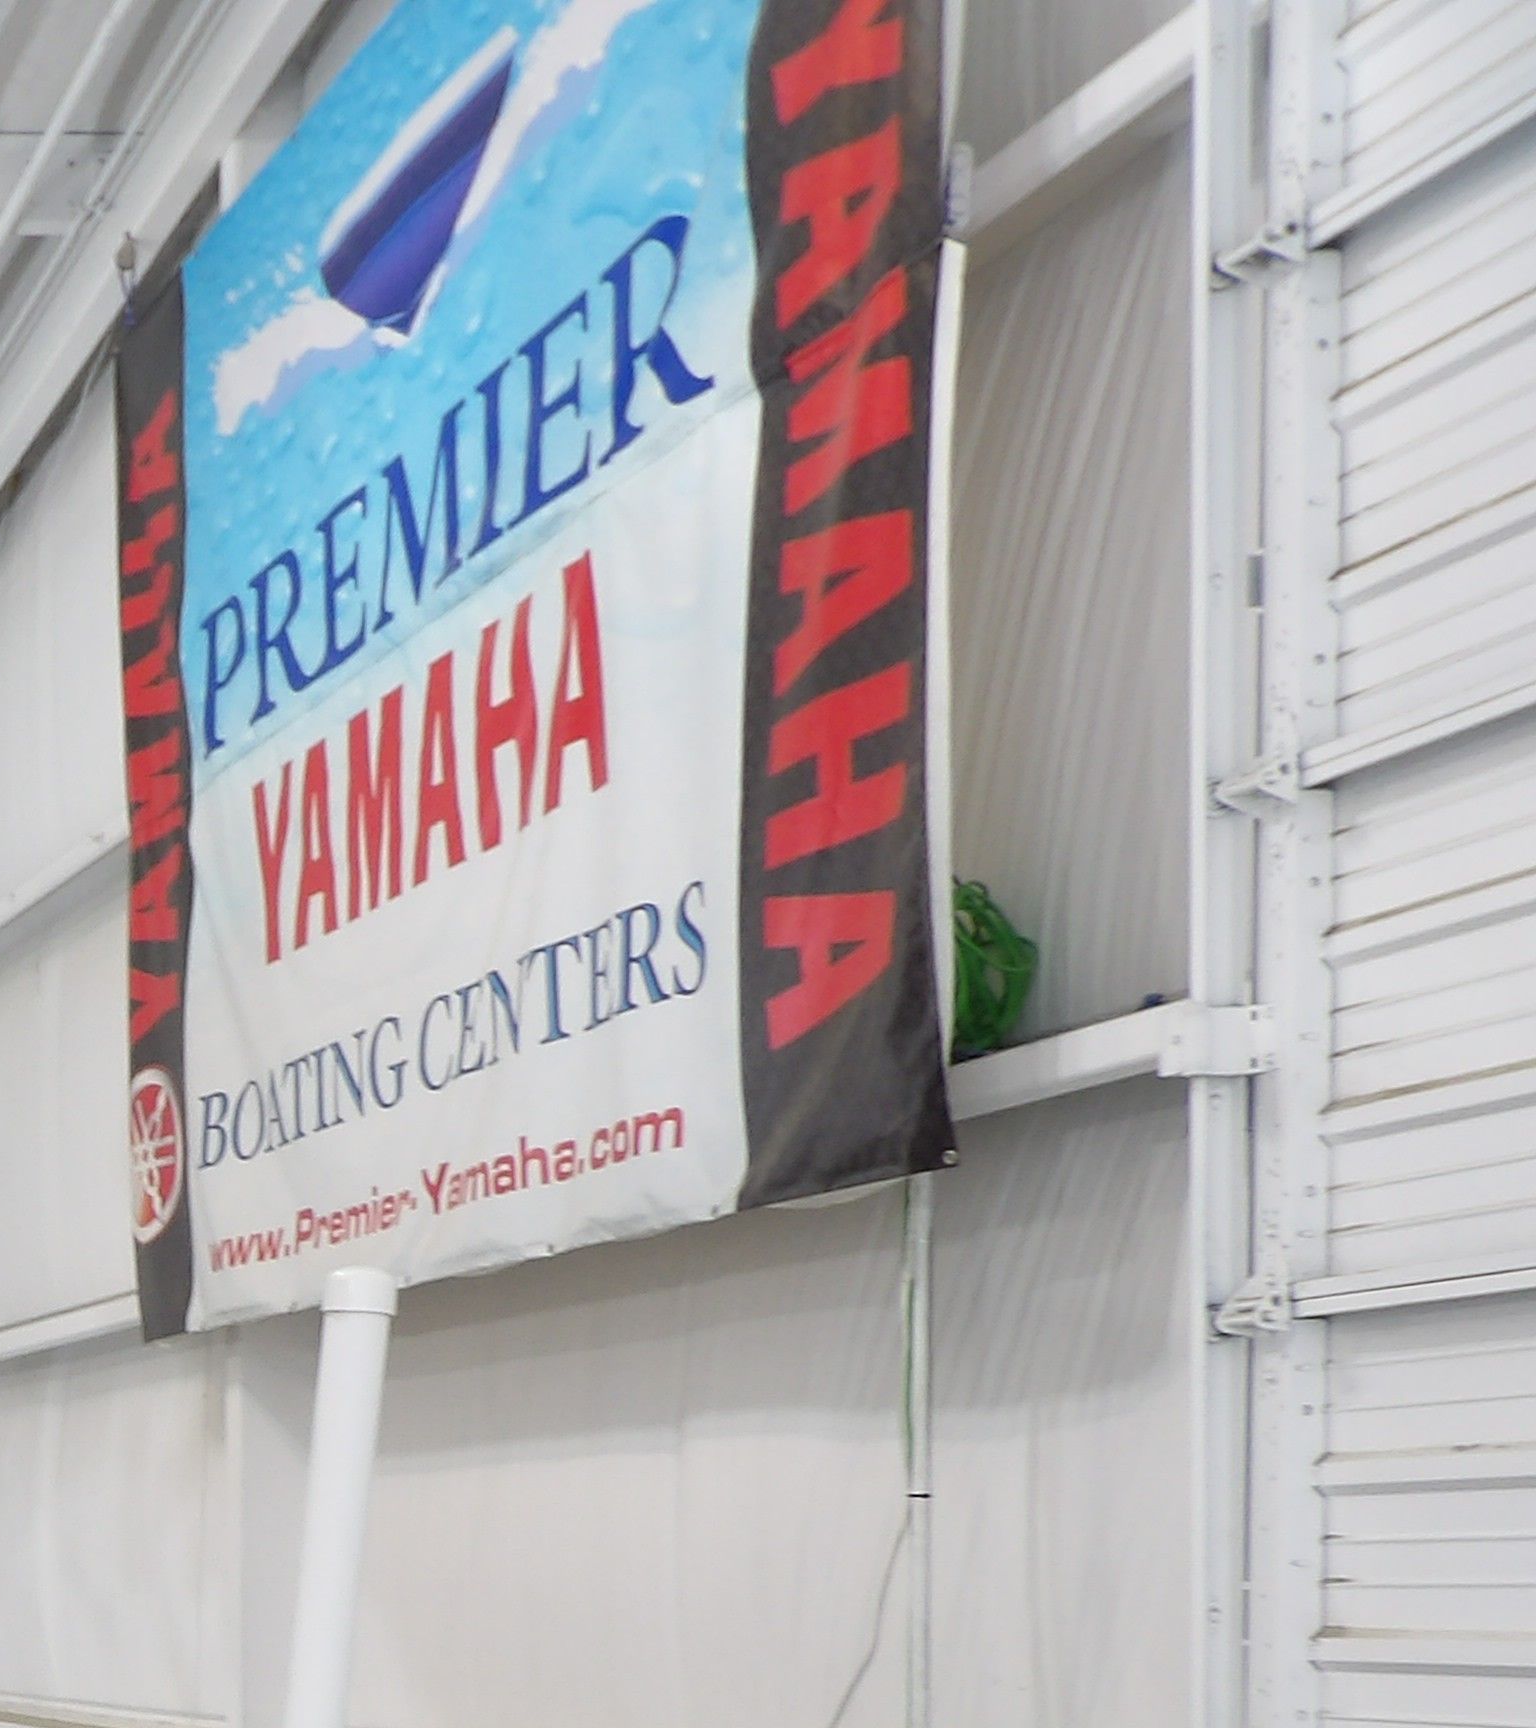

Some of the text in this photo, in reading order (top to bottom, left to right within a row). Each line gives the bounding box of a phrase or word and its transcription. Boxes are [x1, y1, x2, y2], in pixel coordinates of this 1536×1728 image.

[200, 214, 715, 759] PREMIER
[766, 0, 915, 1052] YAMAHA
[253, 549, 608, 964] YAMAHA
[199, 880, 707, 1169] BOATING CENTERS
